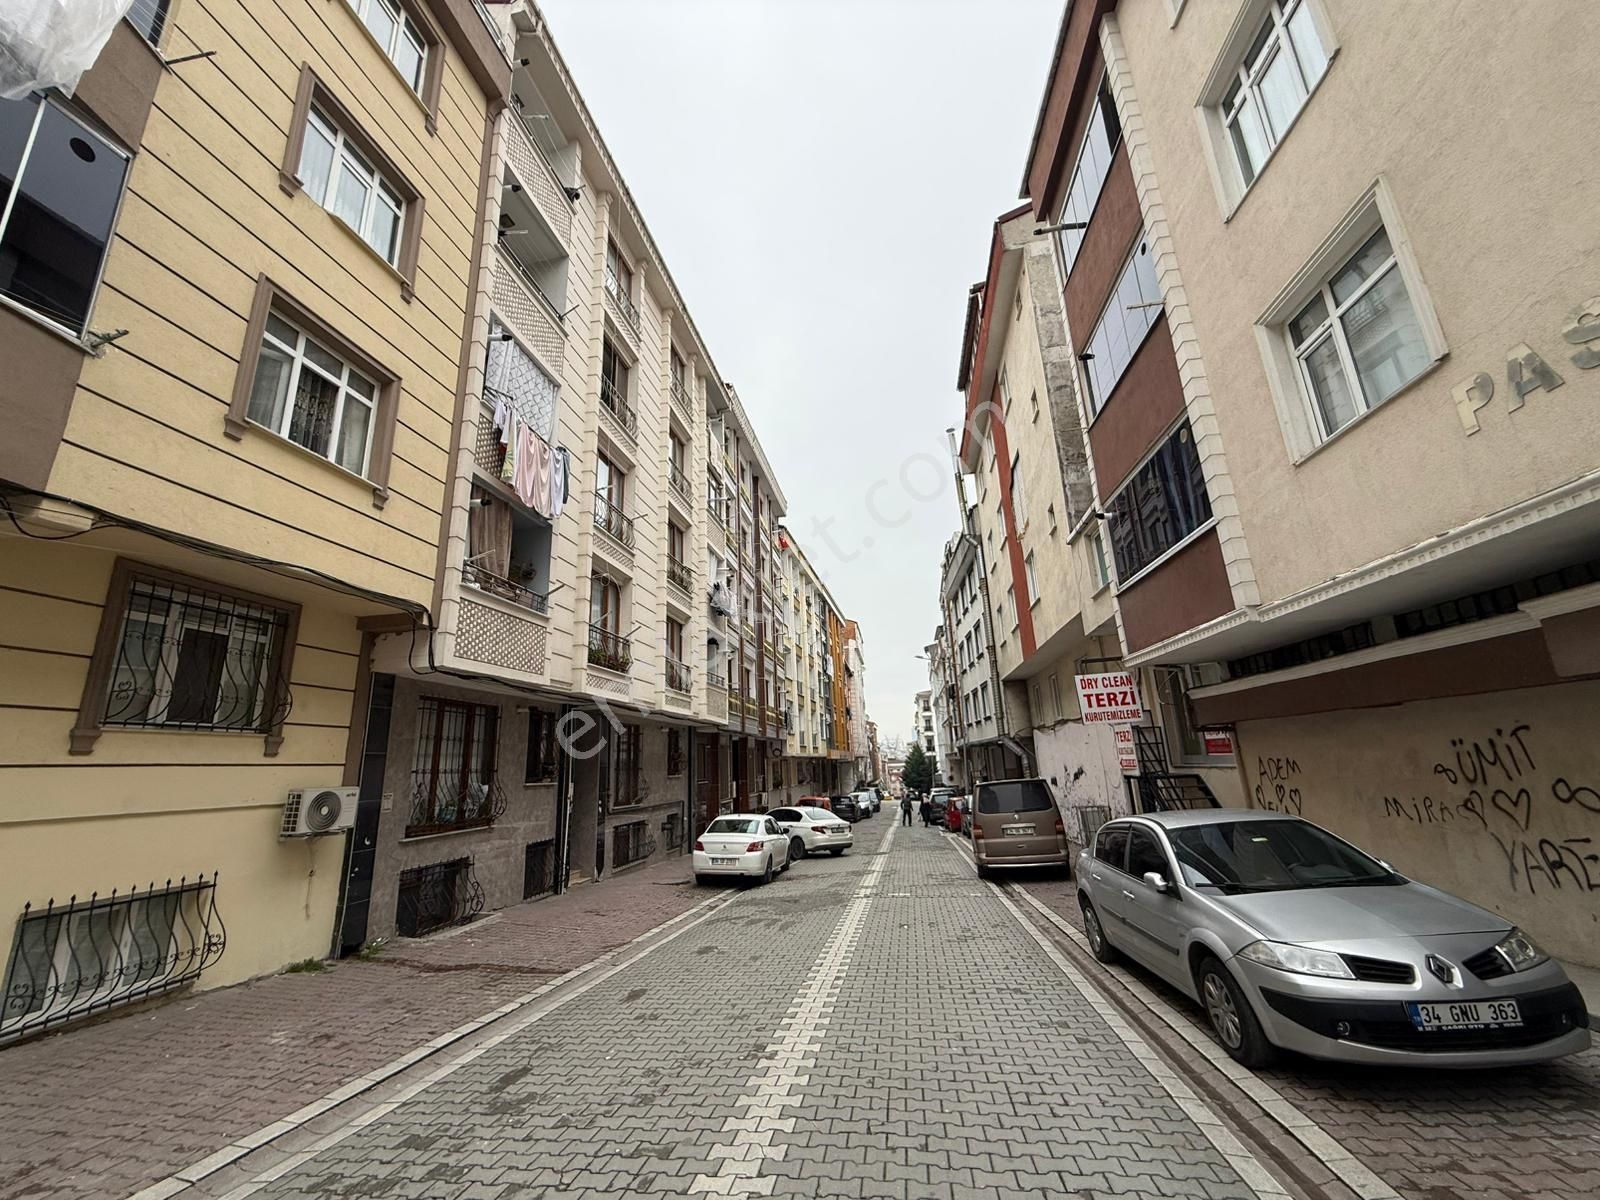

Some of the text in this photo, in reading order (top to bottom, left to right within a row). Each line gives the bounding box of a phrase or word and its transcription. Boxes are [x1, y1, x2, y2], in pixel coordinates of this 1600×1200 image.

[1080, 675, 1133, 690] DRY CLEAN
[1083, 687, 1137, 708] TERZİ
[1451, 725, 1535, 785] ÜMİT
[1258, 756, 1302, 786] ADEM
[1420, 1003, 1519, 1023] 34 GNU 363
